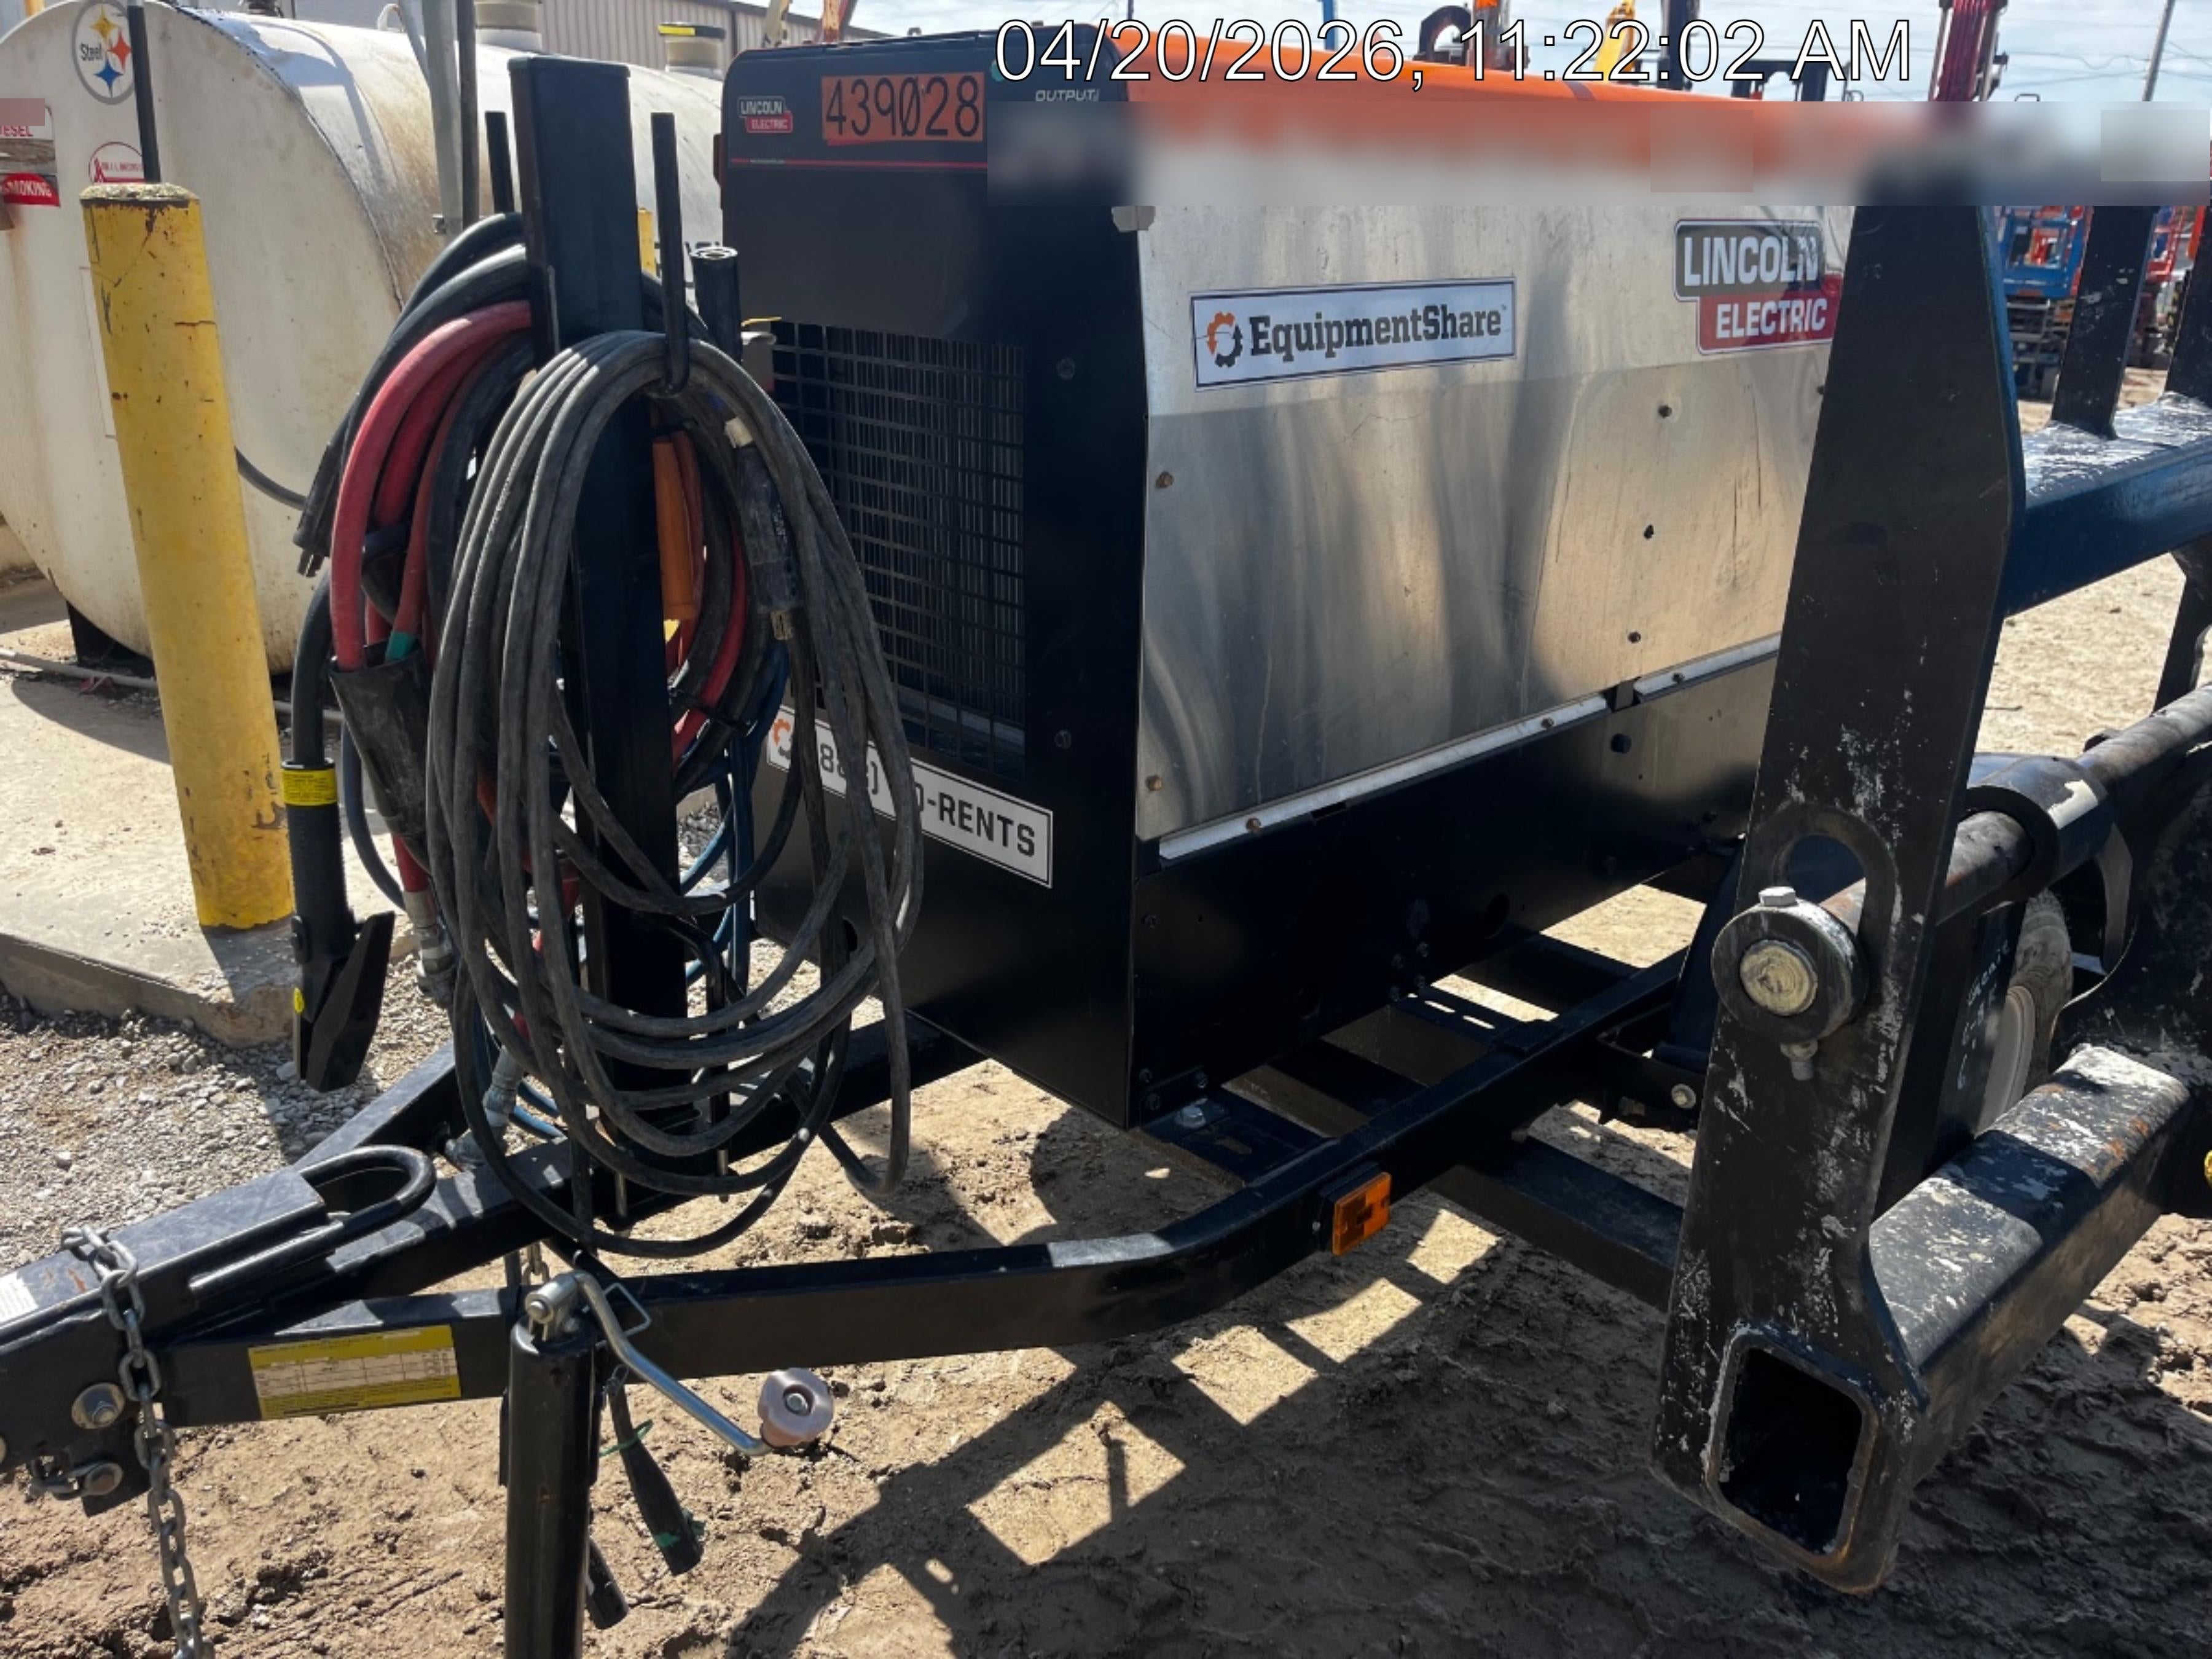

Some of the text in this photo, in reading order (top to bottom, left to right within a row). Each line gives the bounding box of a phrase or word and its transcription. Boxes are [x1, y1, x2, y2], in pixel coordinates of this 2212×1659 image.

[80, 43, 103, 60] Steel
[740, 101, 783, 115] LINCOLN
[751, 119, 788, 130] ELECTRIC
[826, 75, 979, 137] 439028
[1684, 236, 1818, 286] LINCOLN
[1249, 305, 1502, 362] EquipmentShare
[1716, 298, 1827, 339] ELECTRIC
